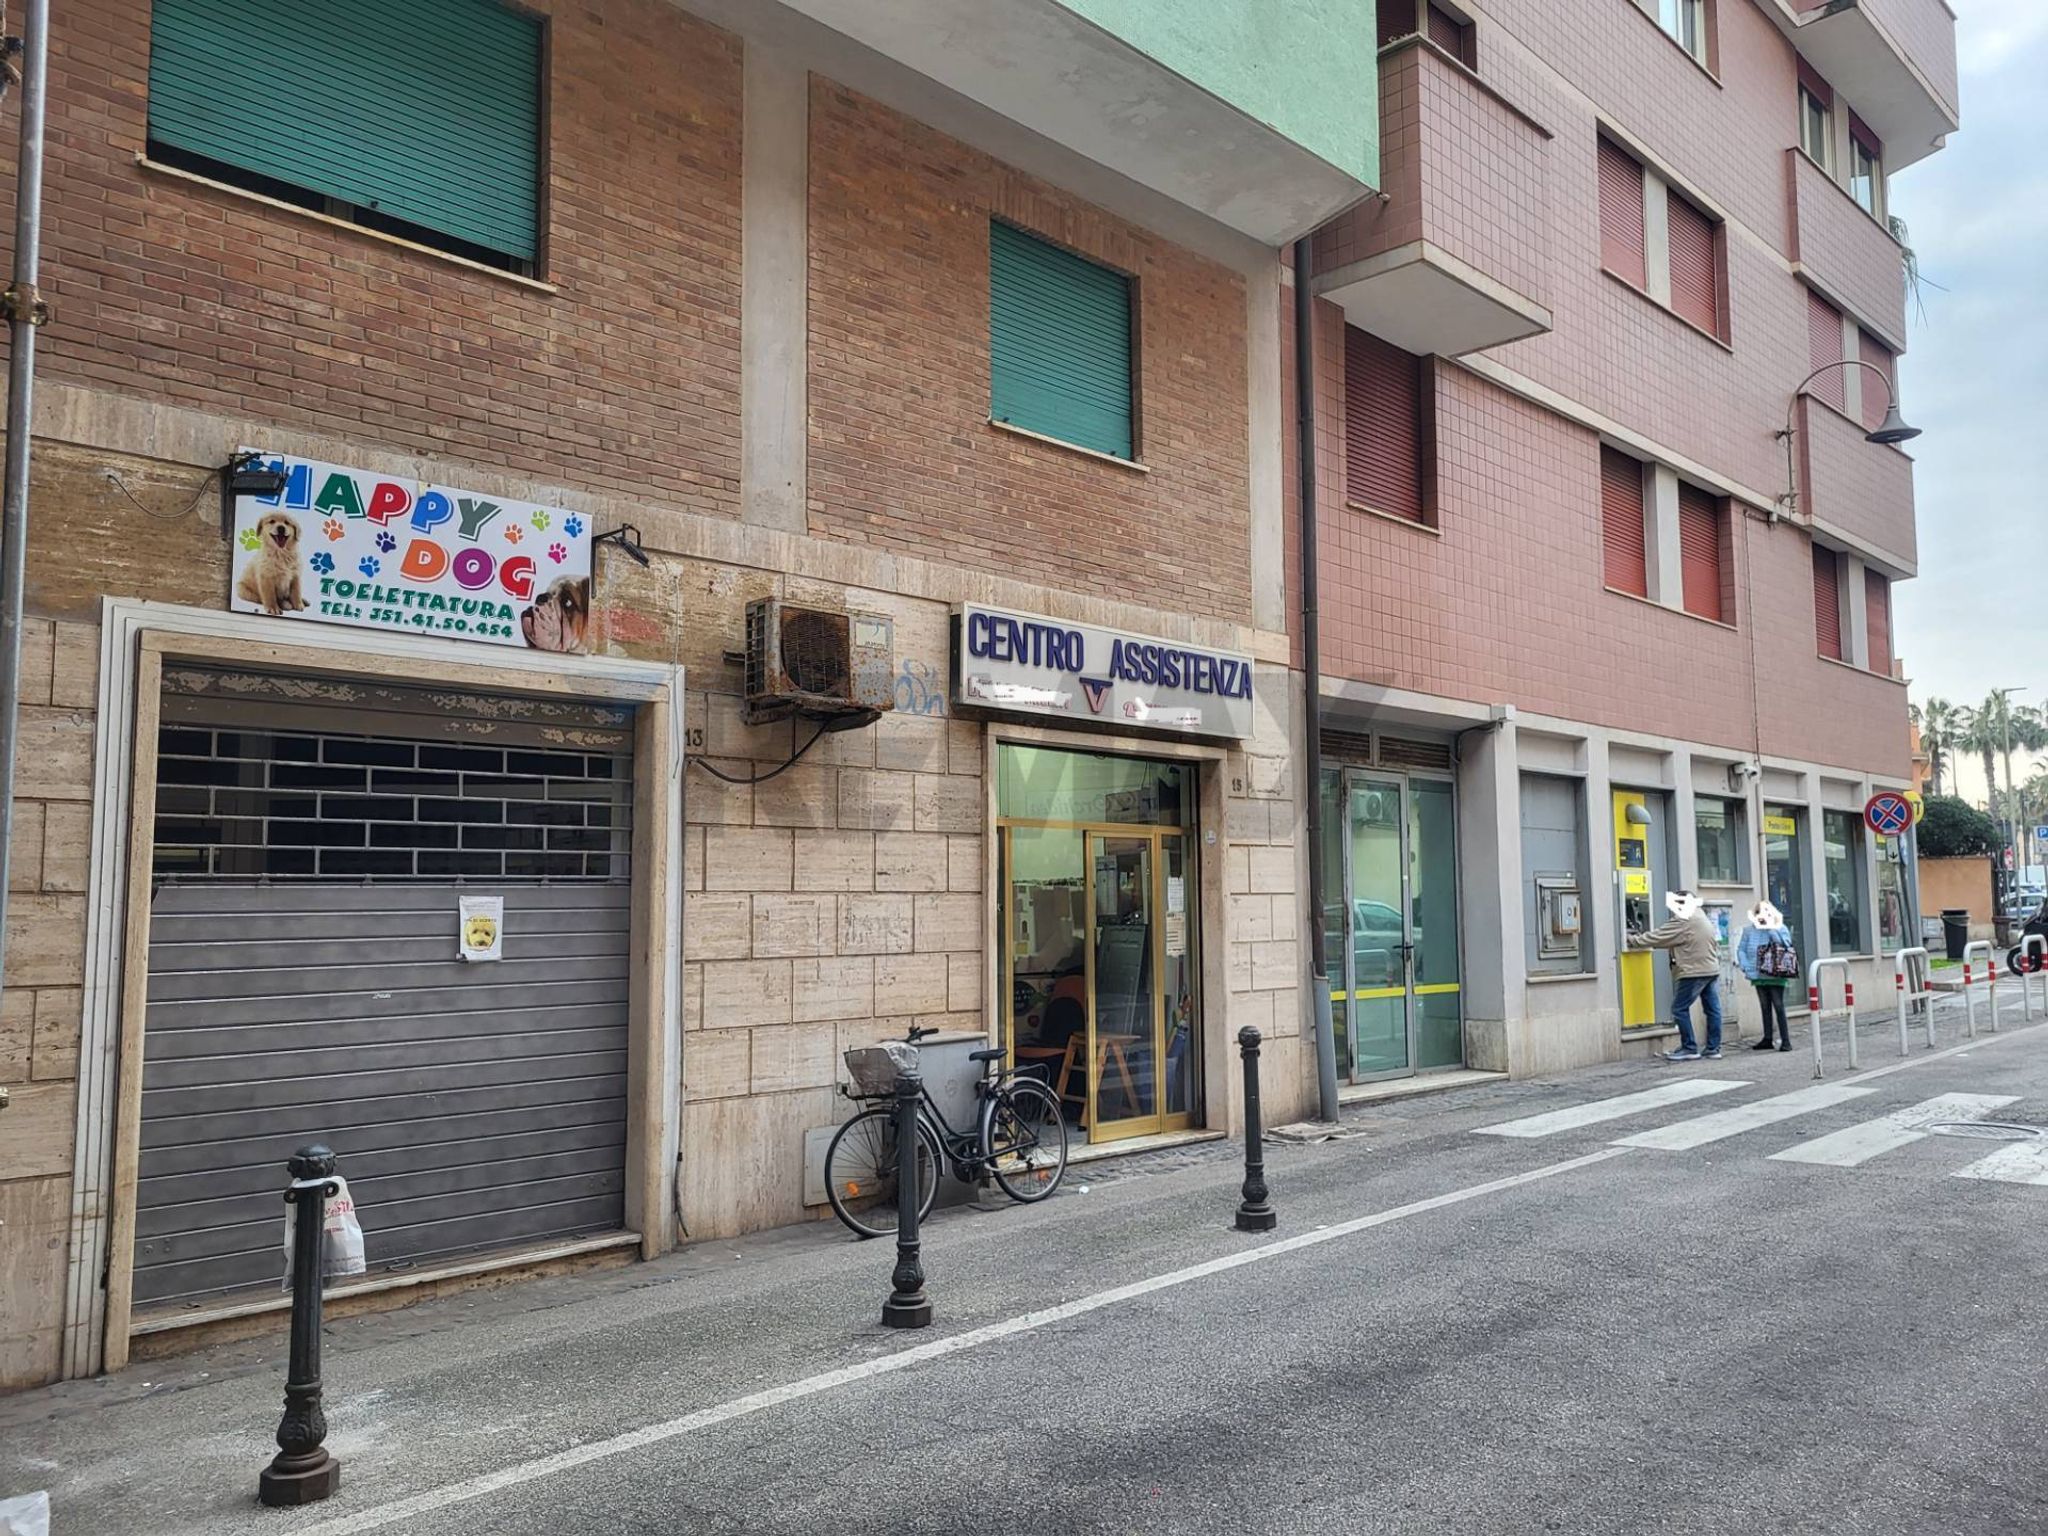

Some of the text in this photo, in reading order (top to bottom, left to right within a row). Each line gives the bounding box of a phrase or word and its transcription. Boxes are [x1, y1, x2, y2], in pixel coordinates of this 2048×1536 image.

[401, 539, 536, 602] DOG
[320, 578, 515, 621] TOELETTATURA
[321, 601, 513, 638] TEL: 351.41.50.454
[967, 612, 1084, 673] CENTRO
[1109, 638, 1253, 700] ASSISTENZA
[685, 728, 703, 746] 13
[1231, 777, 1242, 792] 15
[2040, 828, 2047, 838] P
